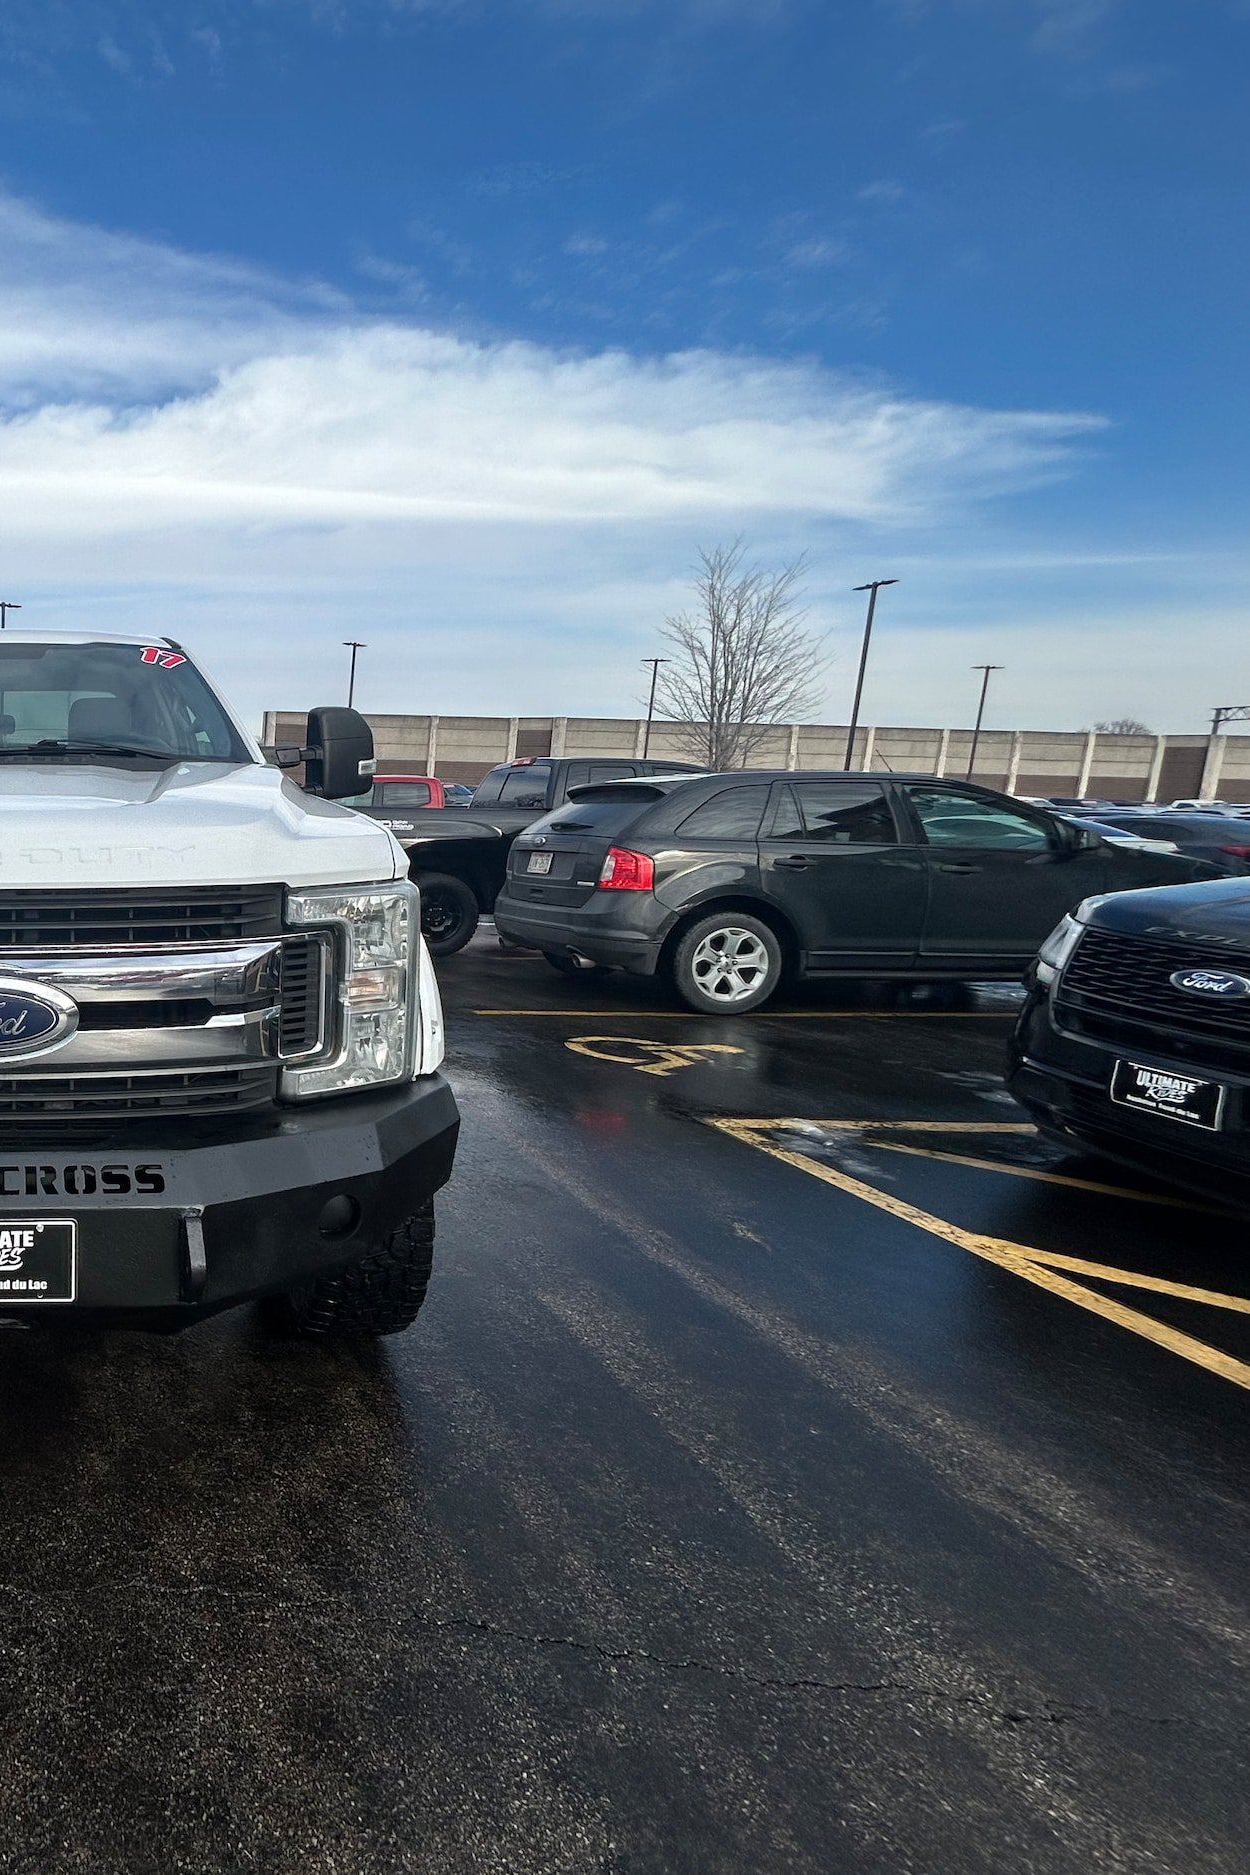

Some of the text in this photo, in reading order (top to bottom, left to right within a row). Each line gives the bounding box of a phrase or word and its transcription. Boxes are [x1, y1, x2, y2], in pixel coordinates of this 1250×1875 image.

[140, 646, 187, 669] 17
[19, 845, 197, 868] DUTY
[1144, 926, 1250, 949] EXPL
[1182, 972, 1234, 992] Ford
[1136, 1070, 1197, 1093] ULTIMATE
[12, 1279, 28, 1290] du
[29, 1279, 48, 1290] Lac
